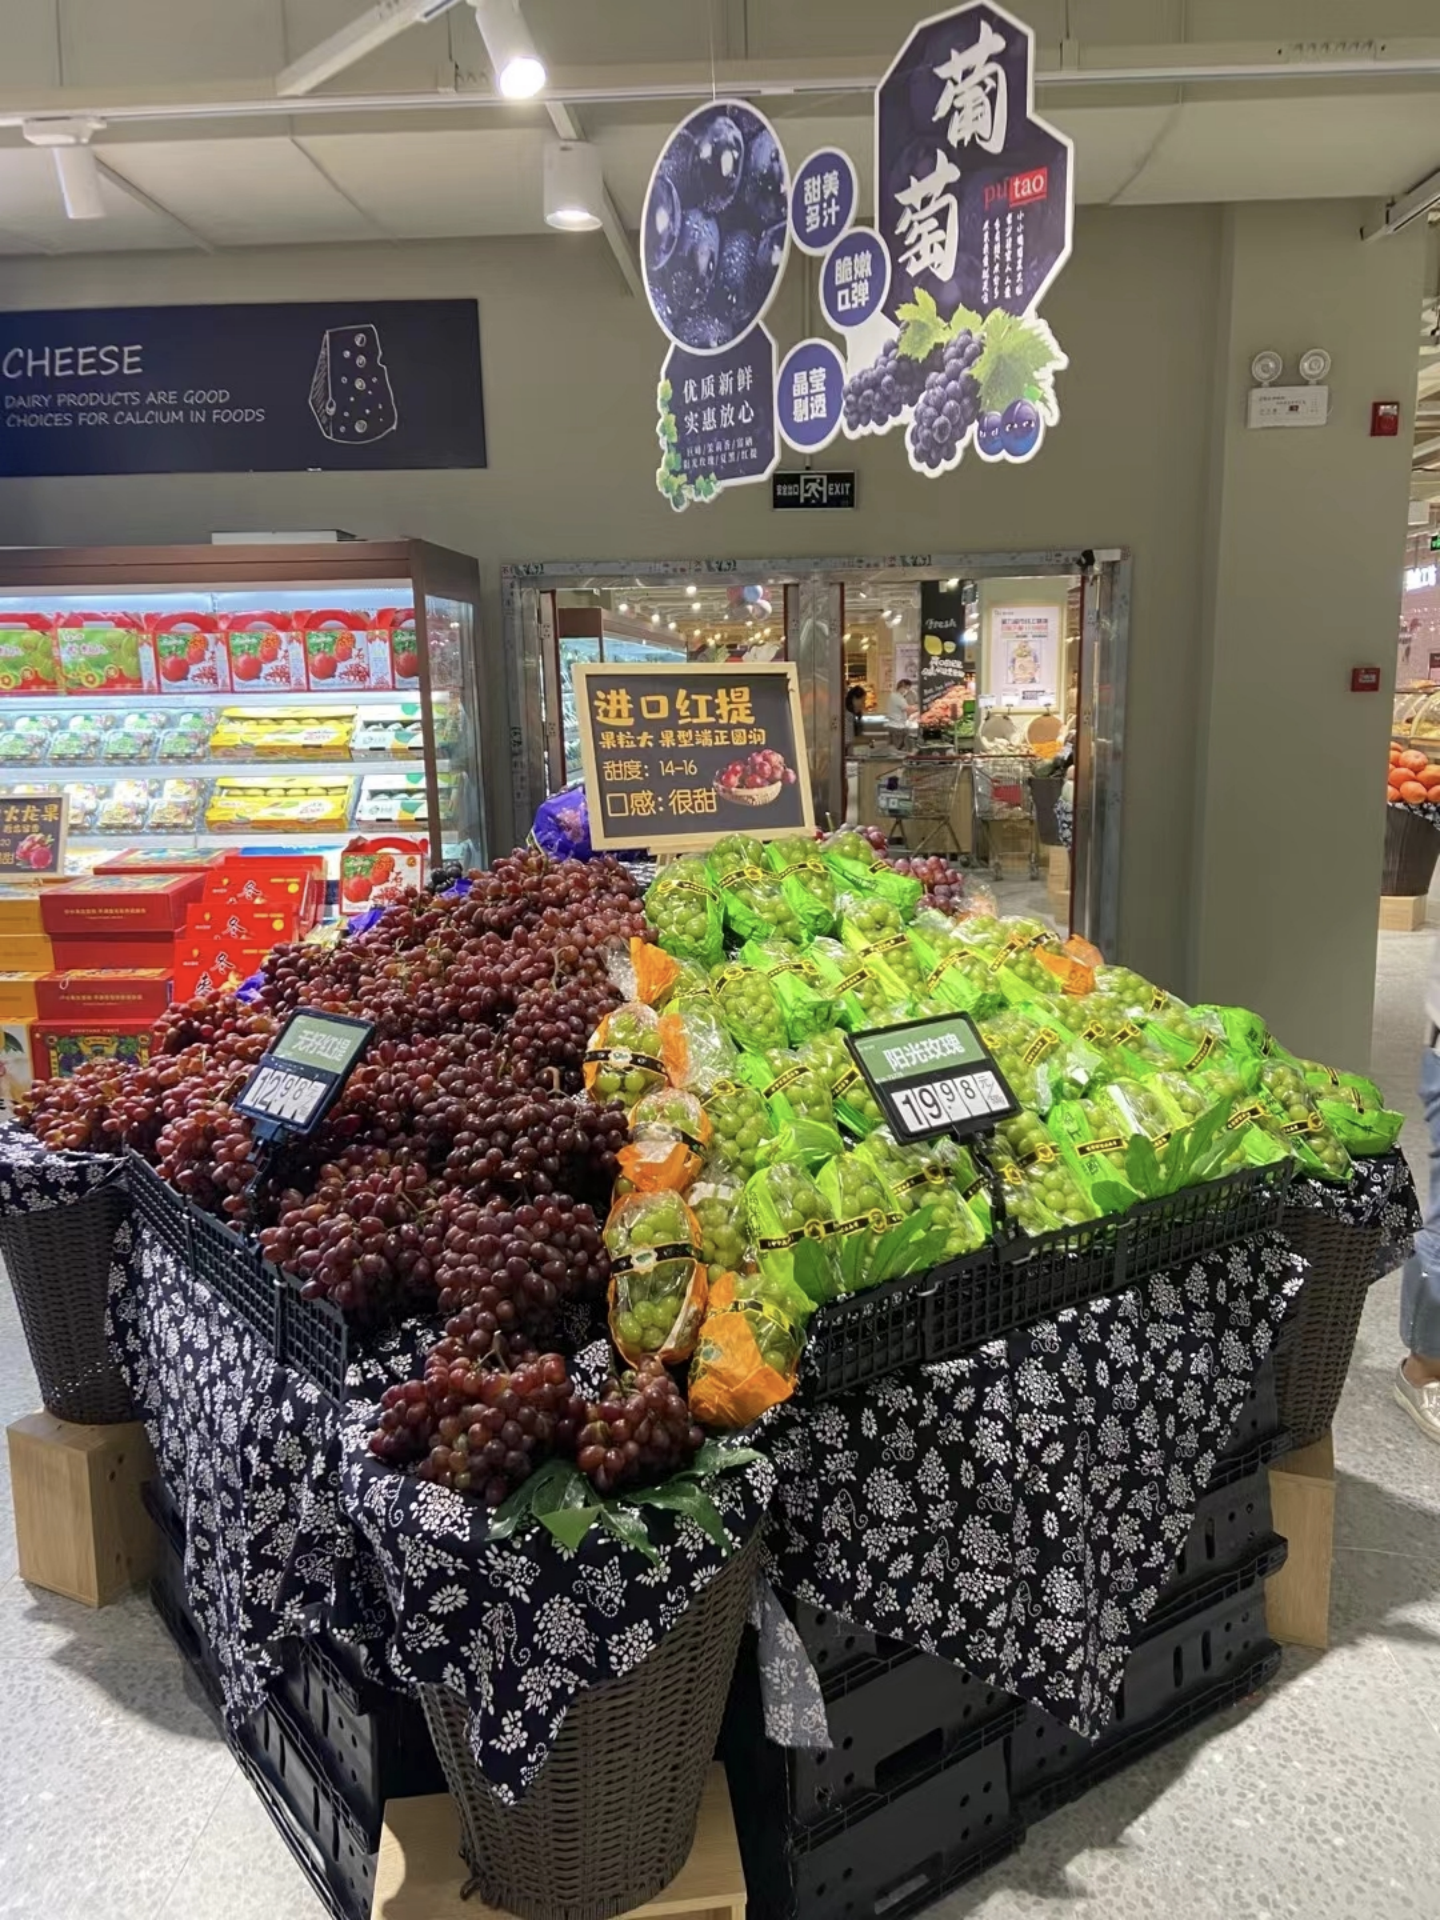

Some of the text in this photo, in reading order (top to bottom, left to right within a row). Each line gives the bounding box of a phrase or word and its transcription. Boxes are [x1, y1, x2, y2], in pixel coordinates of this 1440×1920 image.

[894, 20, 1007, 282] 葡萄
[804, 170, 840, 205] 甜美
[1013, 174, 1044, 199] tao
[806, 198, 840, 233] 多汁
[834, 250, 872, 285] 脆嫩
[837, 280, 870, 312] 口弹
[3, 344, 143, 379] CHEESE
[683, 365, 753, 404] 优质新鲜
[792, 367, 827, 396] 晶莹
[4, 389, 230, 408] DAIRY PRODUCTS ARE GOOD
[793, 396, 827, 423] 剔透
[6, 408, 265, 427] CHOICES FOR CALCIUM IN FOODS
[684, 400, 755, 435] 实惠放心
[828, 482, 851, 496] EXIT
[594, 686, 755, 727] 进口红提
[599, 728, 766, 749] 果粒大 果型端正圆润
[659, 759, 698, 777] 14-16
[291, 1029, 351, 1061] 无籽红提
[882, 1032, 965, 1072] 阳光玫瑰
